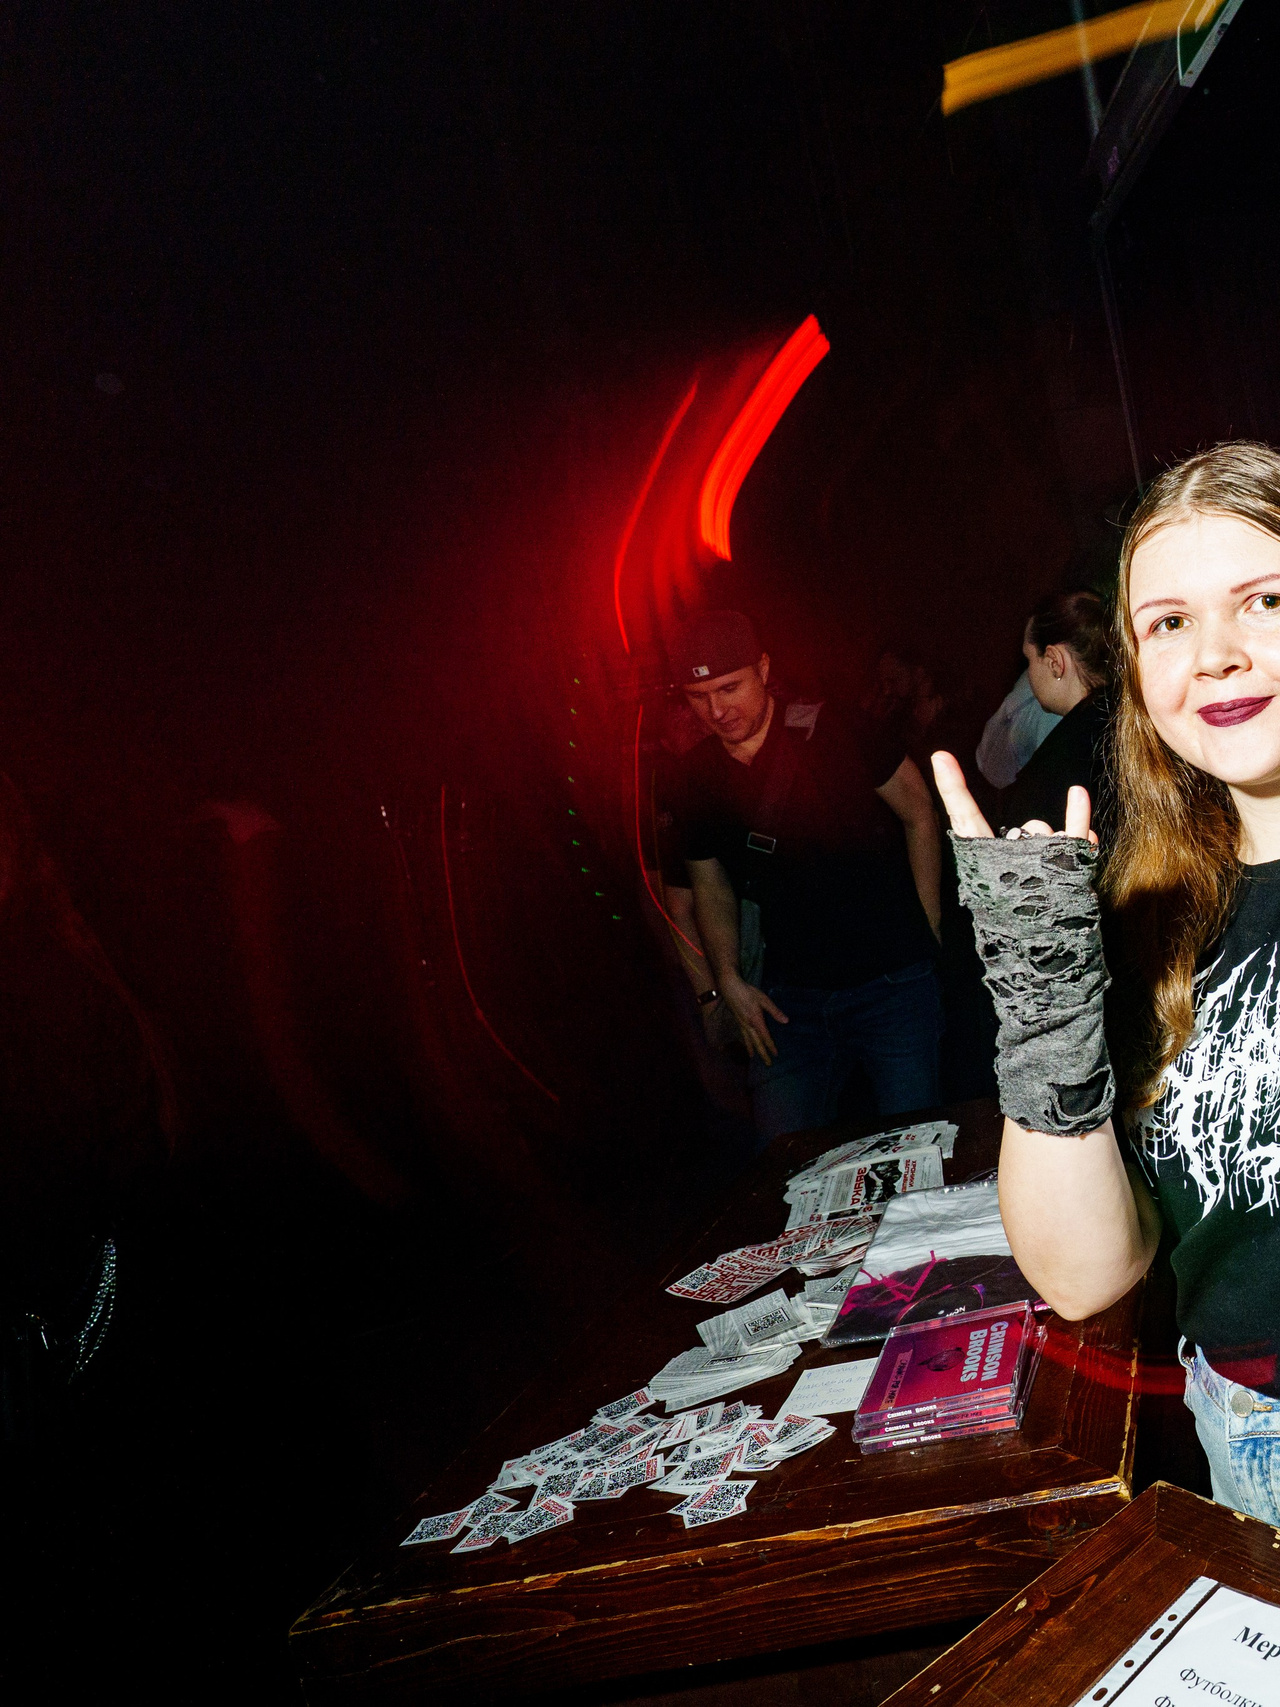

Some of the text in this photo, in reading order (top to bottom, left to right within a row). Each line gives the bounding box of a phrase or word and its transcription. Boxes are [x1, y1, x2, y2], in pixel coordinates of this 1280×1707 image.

[850, 1166, 867, 1206] ЗВУКА
[960, 1328, 988, 1382] BROOKS
[981, 1321, 1009, 1381] CRIMSON
